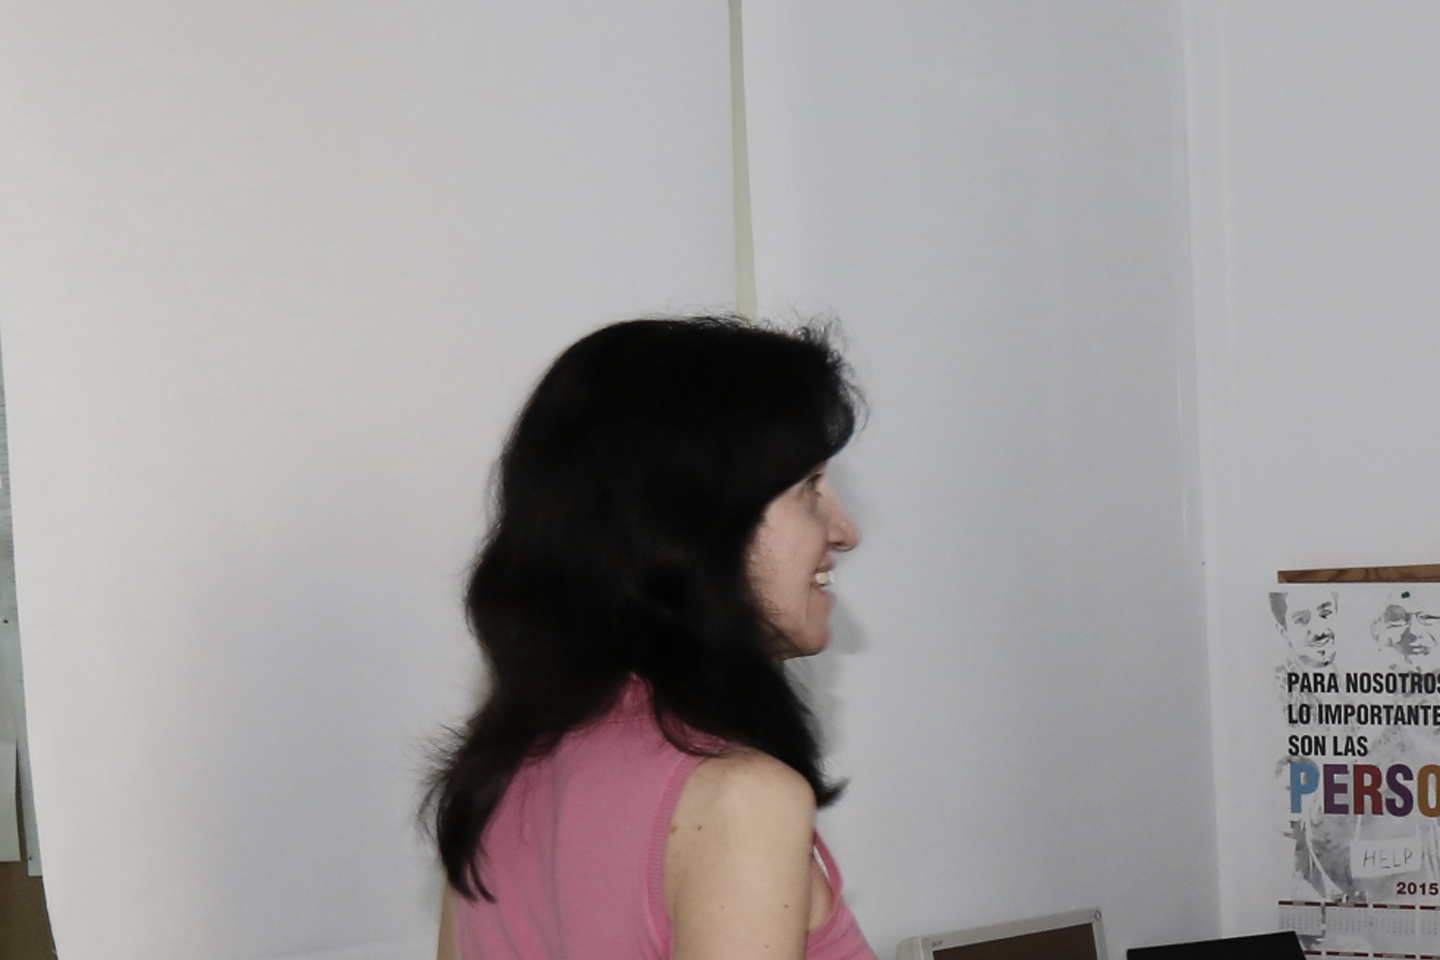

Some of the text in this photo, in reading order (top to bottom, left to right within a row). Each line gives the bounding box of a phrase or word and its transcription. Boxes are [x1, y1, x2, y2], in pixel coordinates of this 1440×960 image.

[1287, 673, 1339, 693] PARA
[1288, 704, 1310, 725] LO
[1288, 735, 1368, 757] SON LAS
[1363, 847, 1413, 869] HELP
[1396, 882, 1439, 896] 2015
